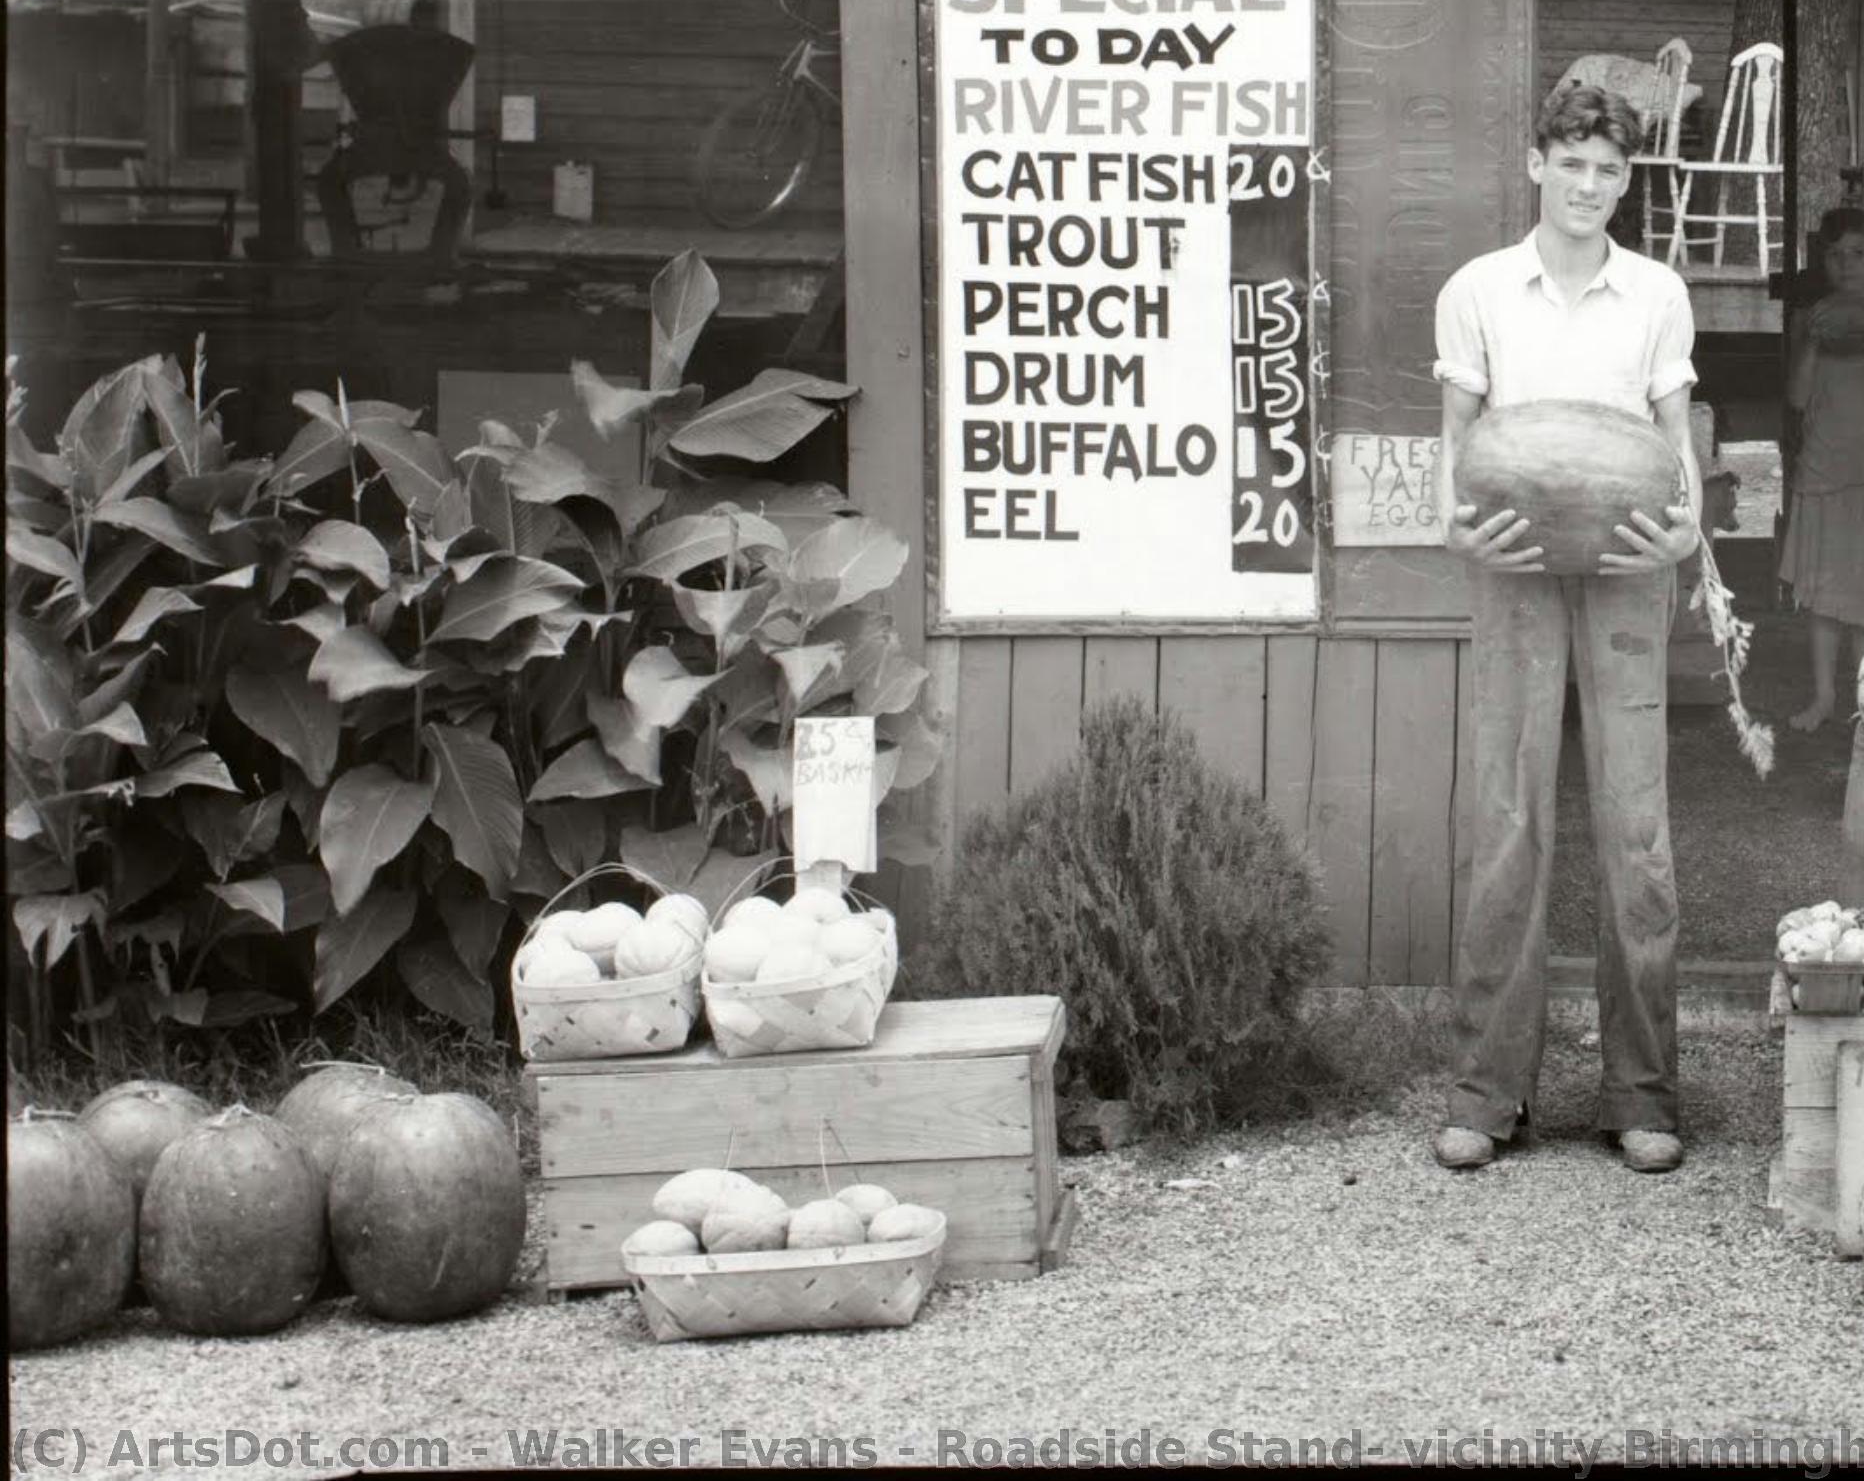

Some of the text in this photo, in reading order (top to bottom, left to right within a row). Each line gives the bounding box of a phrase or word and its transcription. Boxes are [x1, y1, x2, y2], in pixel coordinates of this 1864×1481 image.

[953, 76, 1307, 137] RIVER FISH
[961, 214, 1186, 271] TROUT
[962, 283, 1170, 340] PERCH
[963, 351, 1146, 408] DRUM
[962, 419, 1217, 482] BUFFALO
[963, 487, 1080, 543] EEL
[1232, 490, 1299, 548] 20
